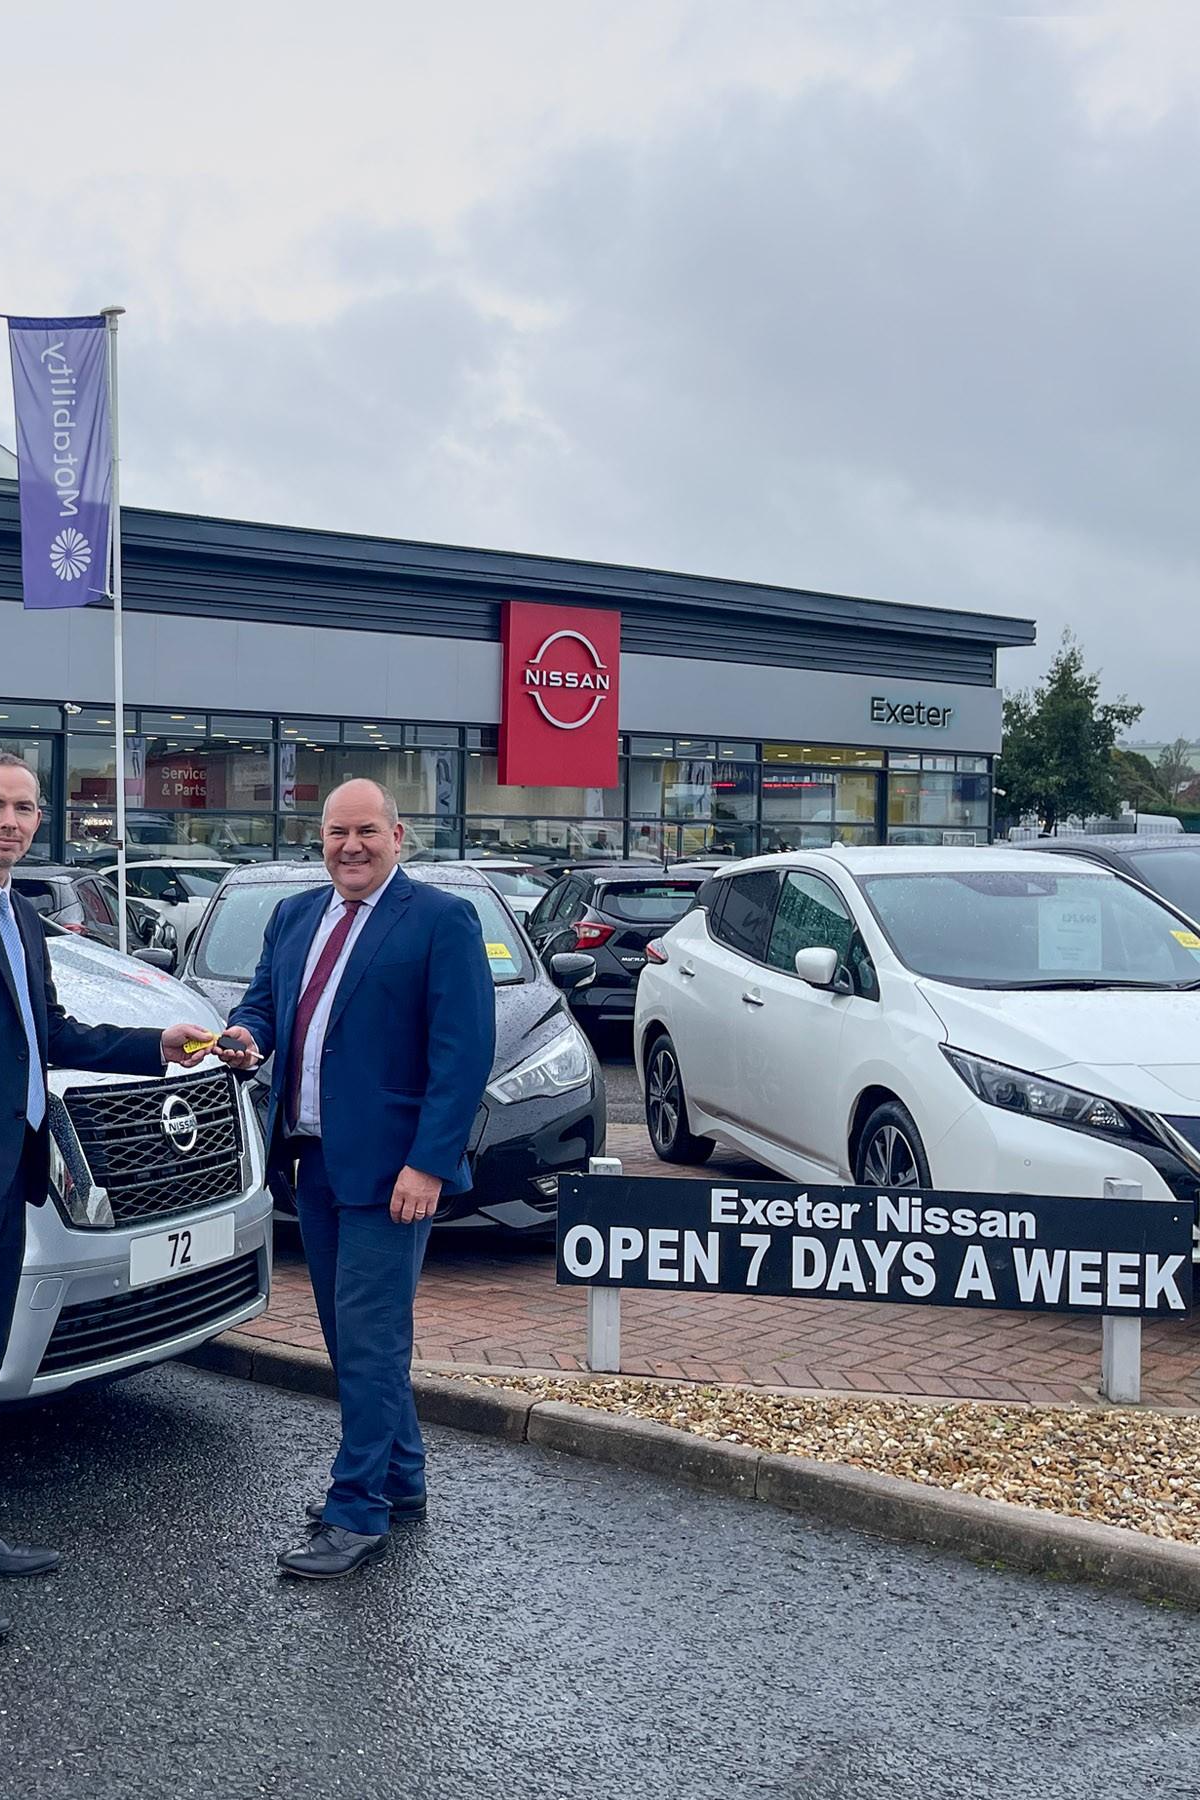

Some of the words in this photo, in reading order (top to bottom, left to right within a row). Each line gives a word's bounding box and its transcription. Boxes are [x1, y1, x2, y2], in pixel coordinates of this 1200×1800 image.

[525, 668, 610, 690] NISSAN
[870, 696, 953, 728] Exeter
[161, 766, 207, 780] Service
[161, 784, 171, 796] &
[174, 783, 208, 797] Parts
[710, 1187, 861, 1231] Exeter
[876, 1195, 1037, 1240] Nissan
[167, 1229, 192, 1268] 72
[563, 1224, 720, 1285] OPEN
[740, 1232, 772, 1287] 7
[791, 1235, 937, 1298] DAYS
[954, 1245, 997, 1301] A
[1012, 1247, 1187, 1311] WEEK
